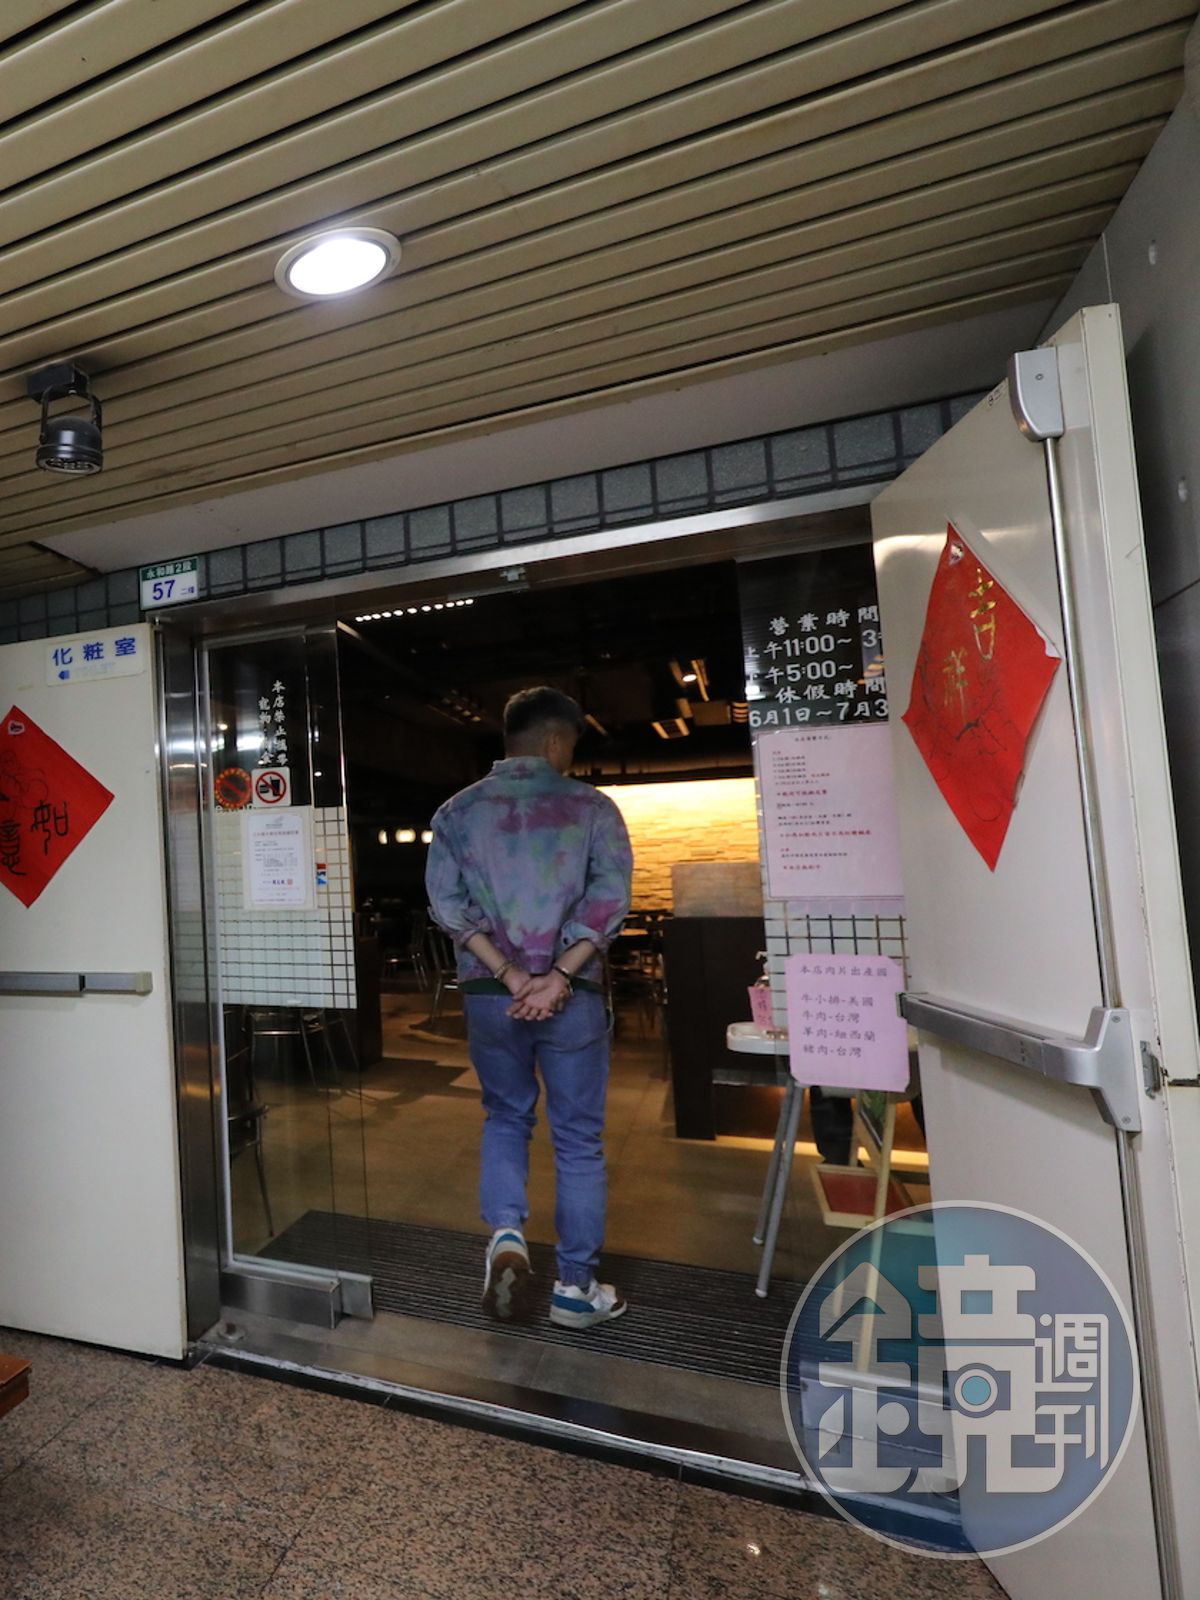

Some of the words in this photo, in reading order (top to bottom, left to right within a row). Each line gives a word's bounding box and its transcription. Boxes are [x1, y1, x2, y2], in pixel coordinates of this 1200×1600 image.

[152, 580, 176, 601] 57
[769, 605, 880, 637] 營業時間
[52, 637, 137, 667] 化粧室
[775, 676, 887, 704] 休假時間
[800, 965, 888, 978] 本店肉片出產國
[802, 1010, 860, 1024] 牛肉-台灣
